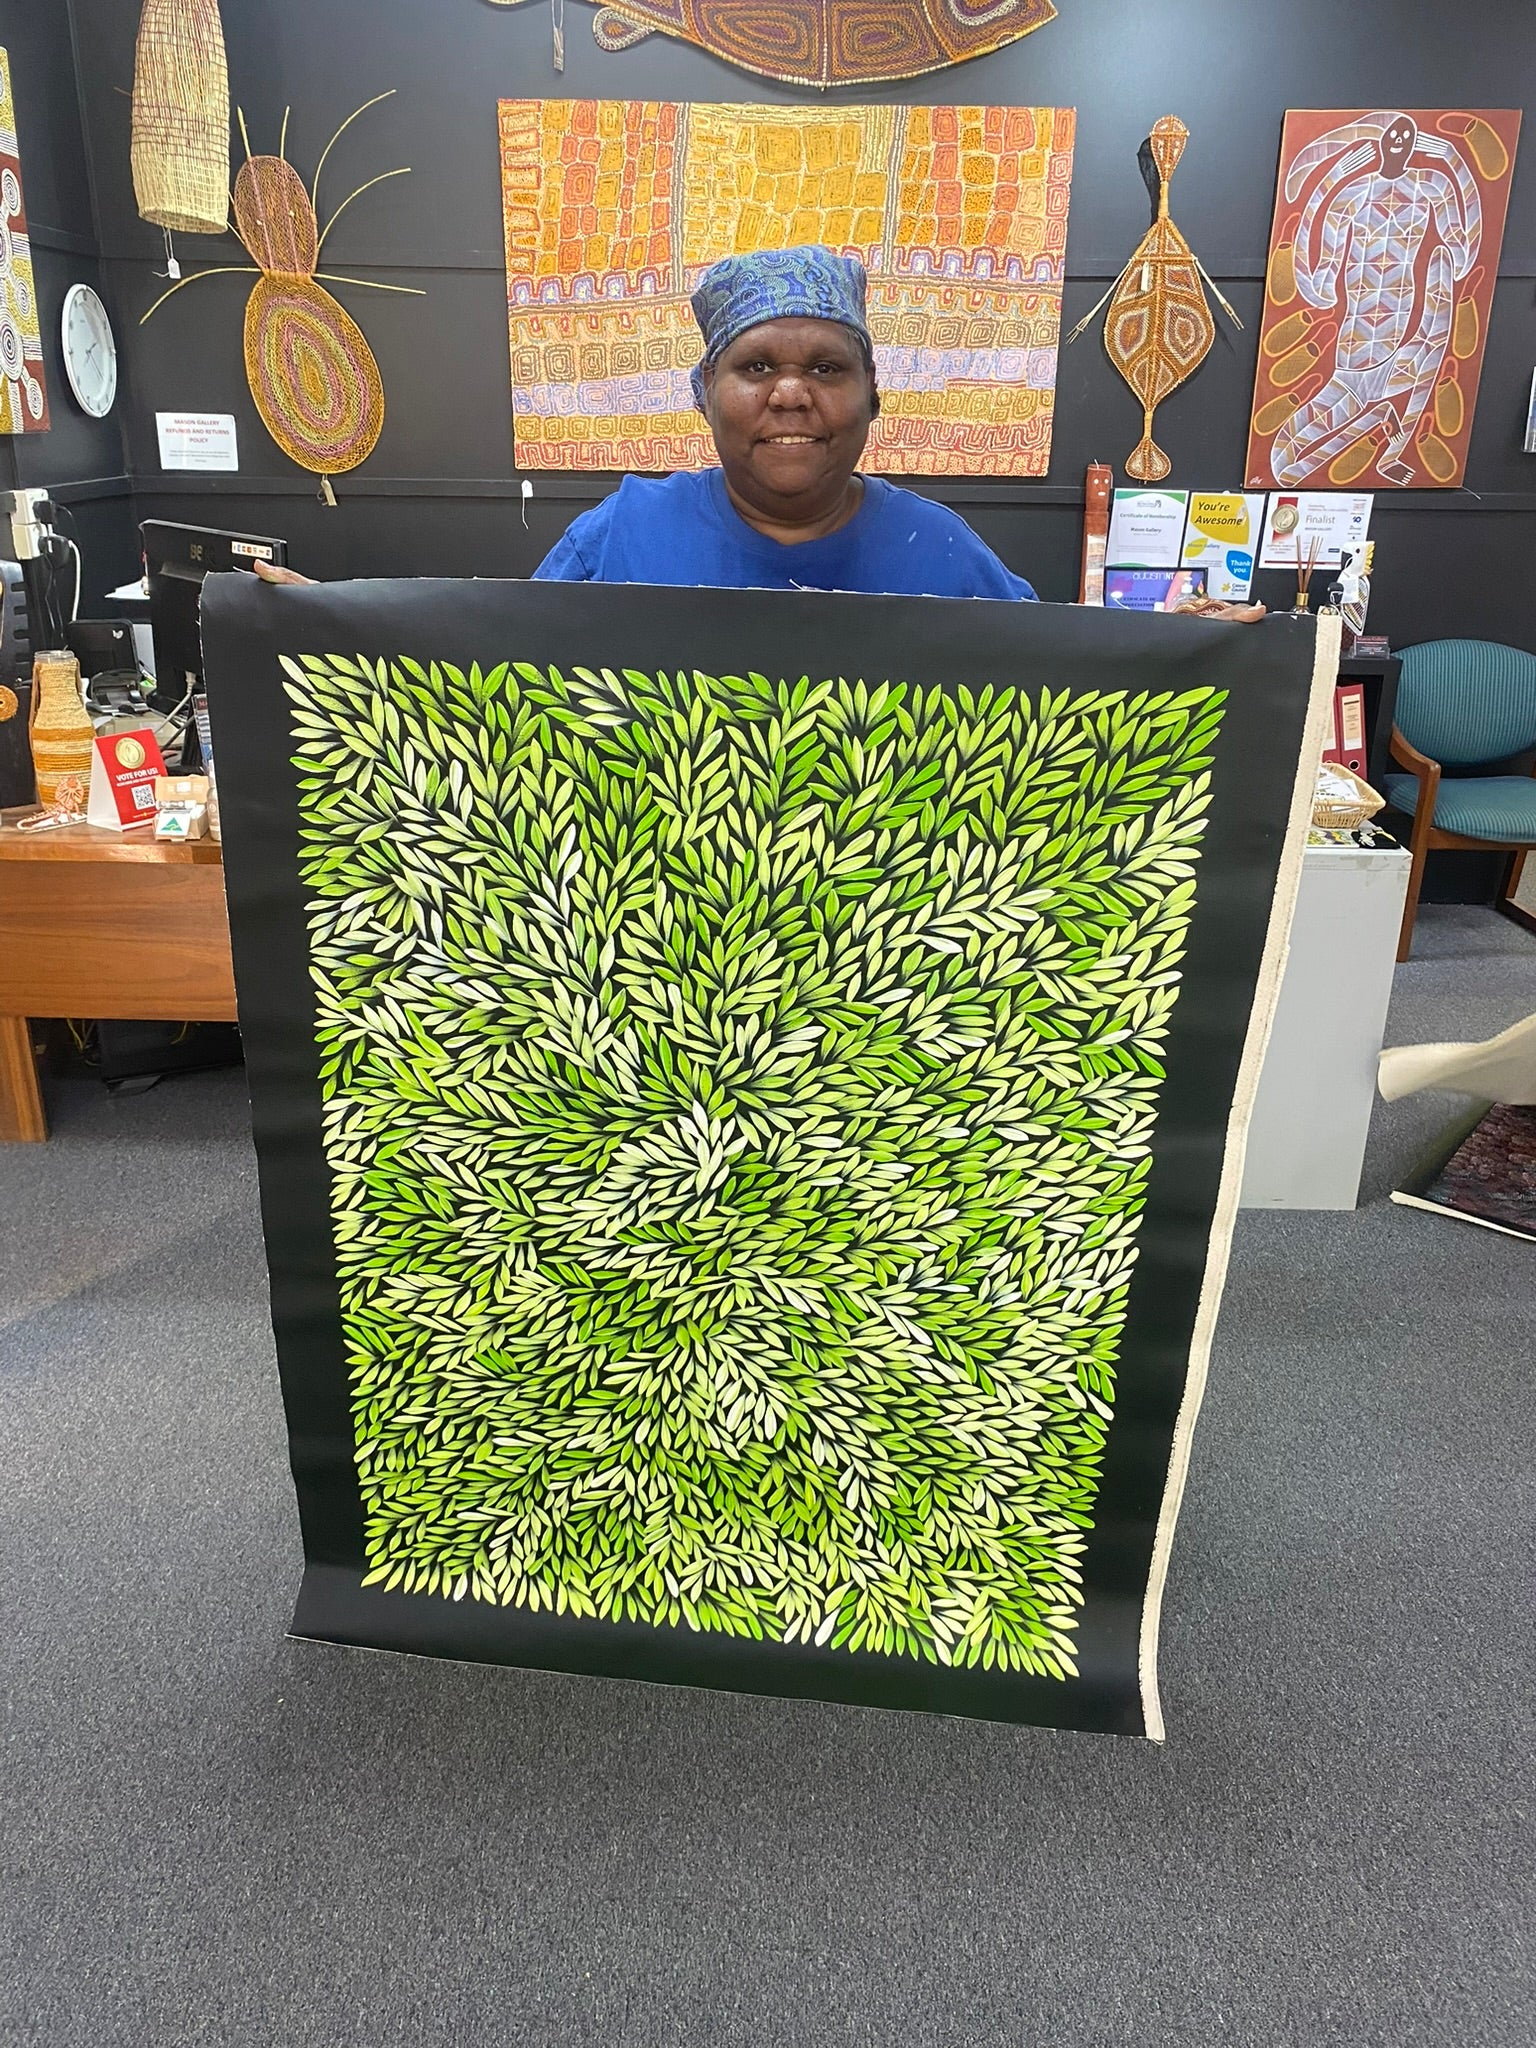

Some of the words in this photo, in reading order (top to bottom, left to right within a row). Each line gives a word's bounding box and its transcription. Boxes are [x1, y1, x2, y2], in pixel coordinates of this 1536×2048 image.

[1198, 502, 1230, 512] You're
[1195, 516, 1243, 526] Awesome
[1306, 515, 1335, 524] Finalist
[1231, 559, 1251, 567] Thank
[116, 772, 134, 781] VOTE
[134, 769, 147, 778] FOR
